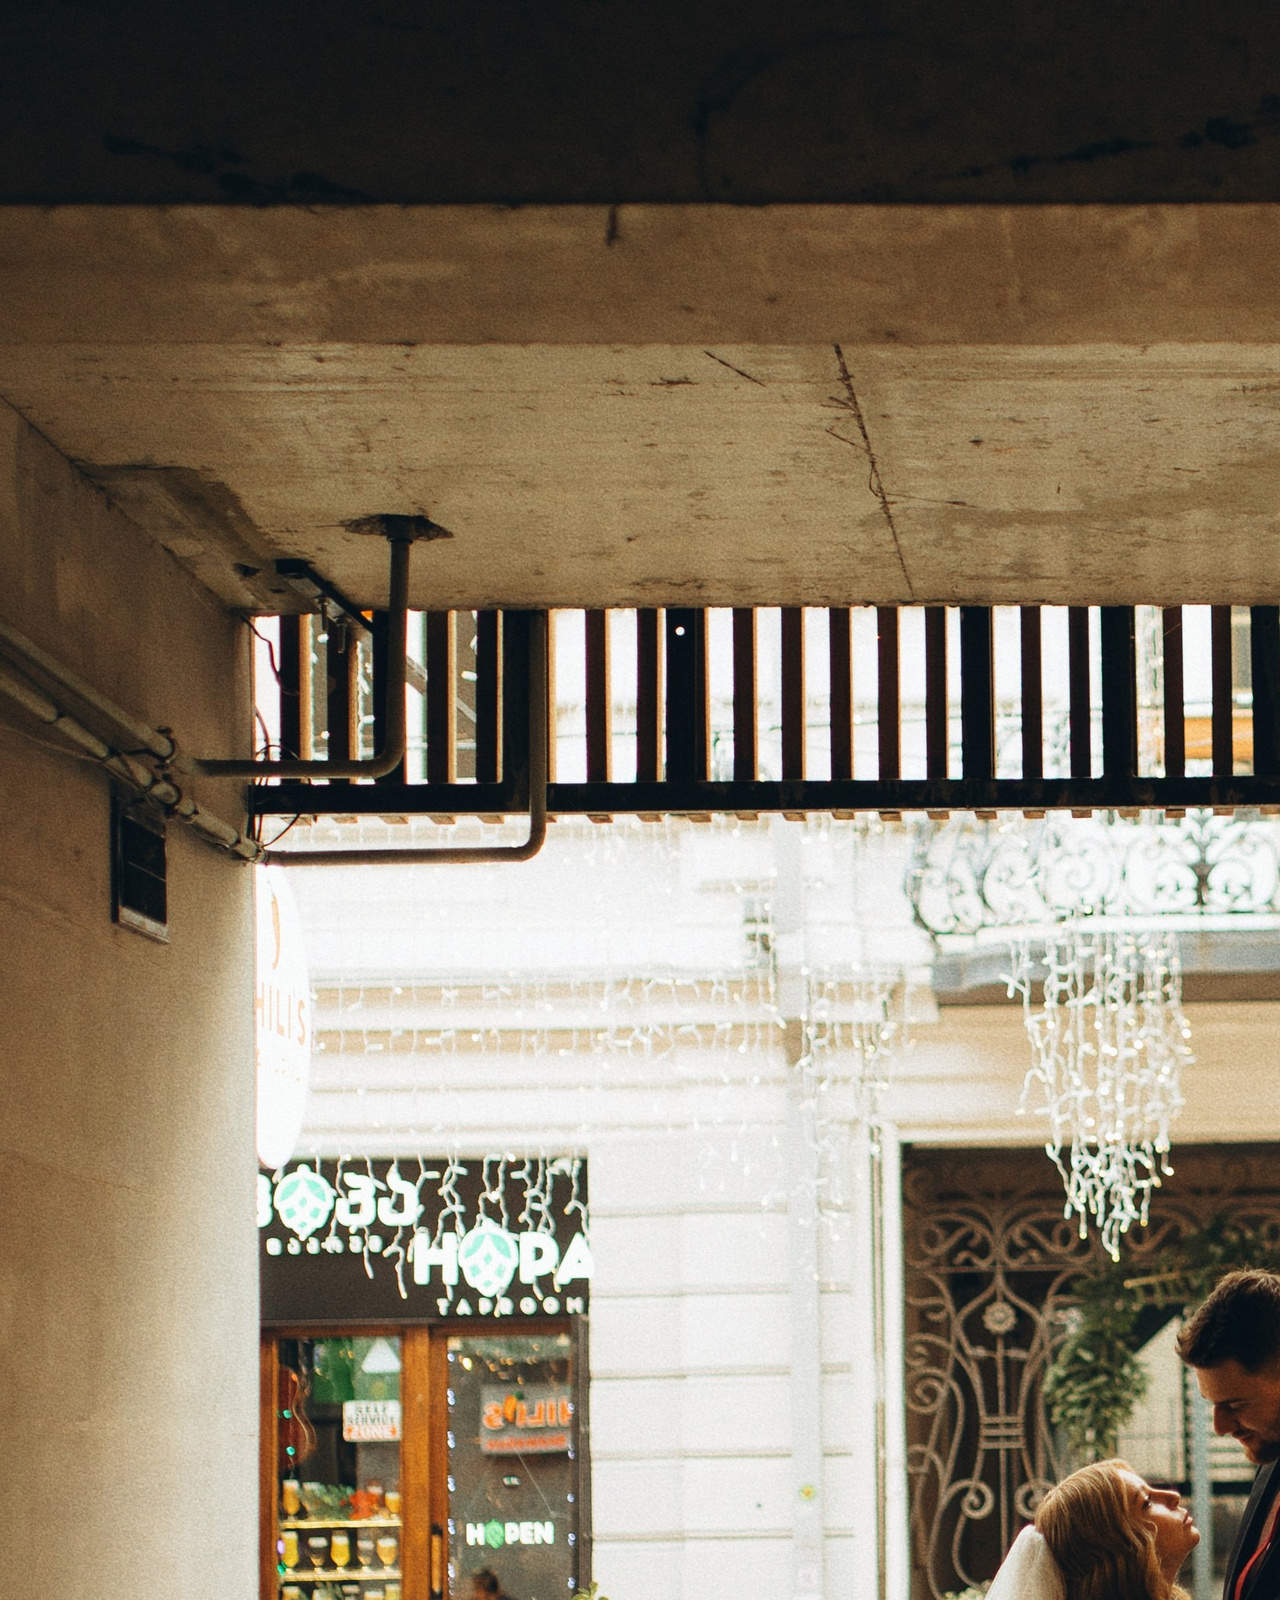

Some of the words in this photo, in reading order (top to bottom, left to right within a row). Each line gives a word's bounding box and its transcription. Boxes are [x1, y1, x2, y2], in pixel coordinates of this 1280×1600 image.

[254, 981, 306, 1046] HILIS
[413, 1218, 594, 1298] HOPA
[436, 1296, 584, 1317] TAPROOM
[346, 1413, 396, 1425] SERVICE
[466, 1519, 555, 1550] HOPEN
